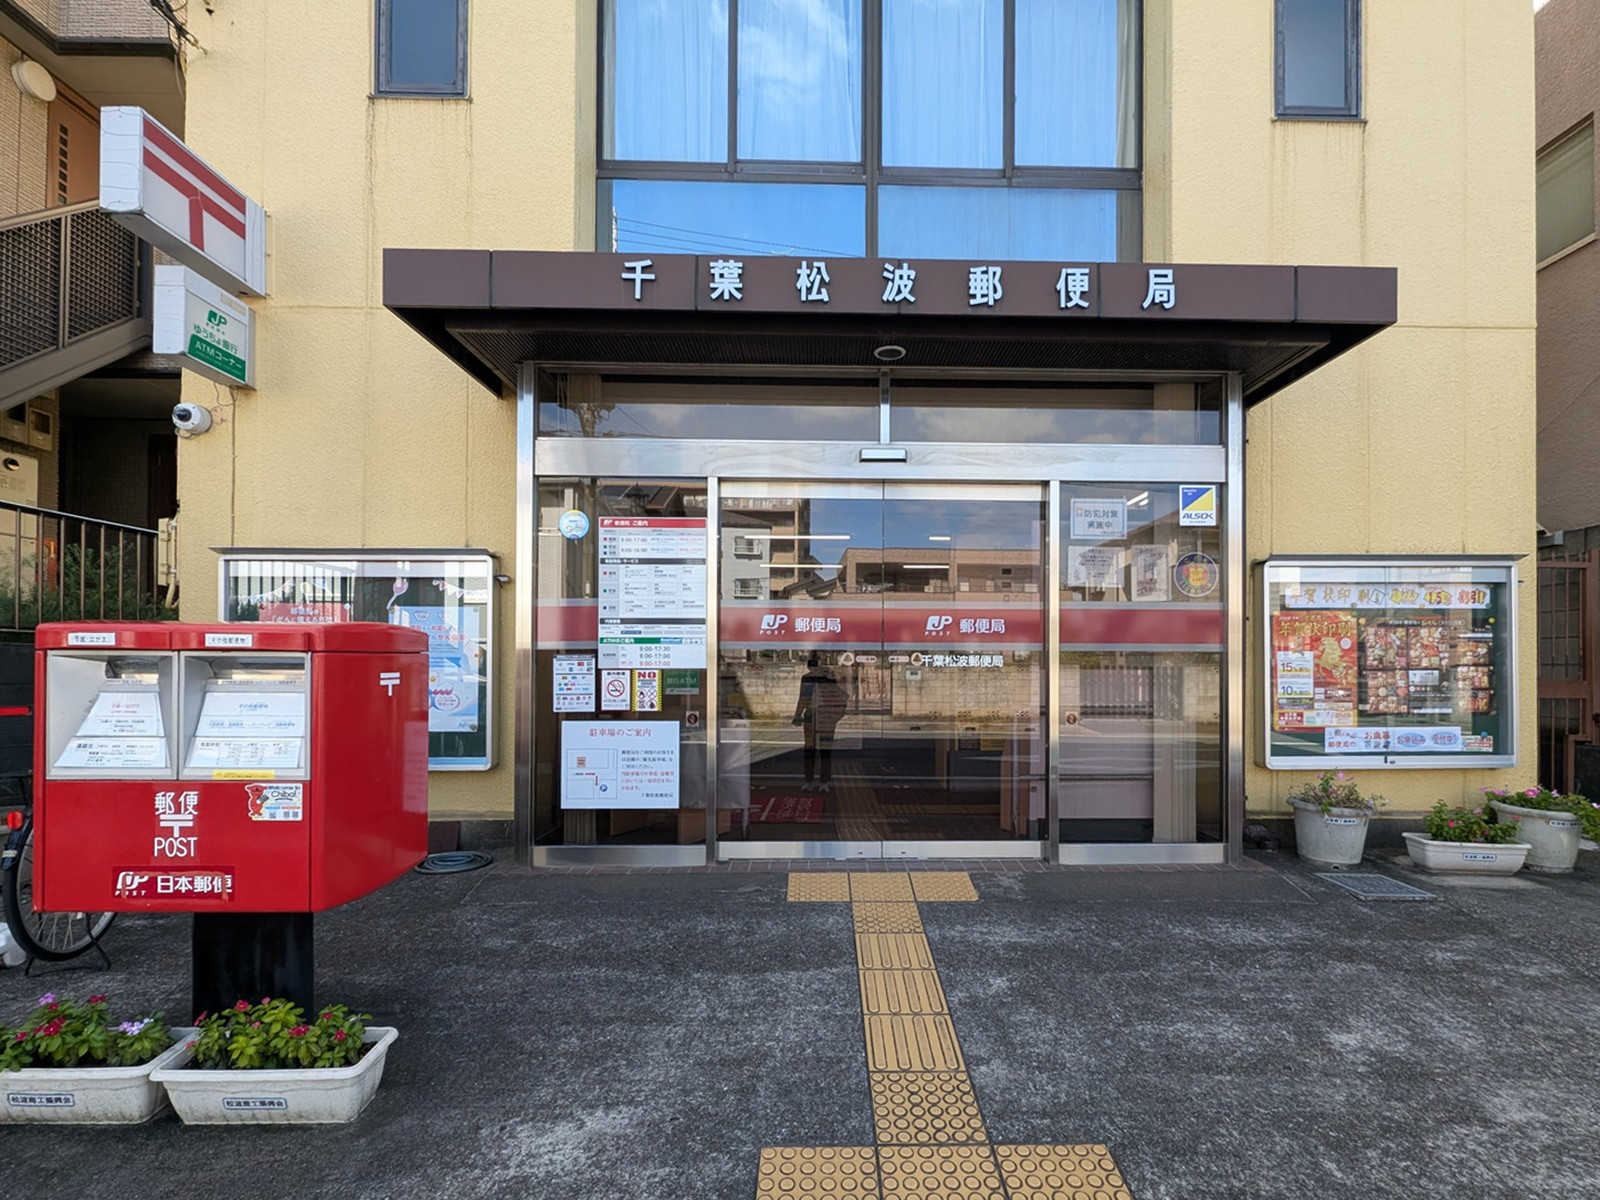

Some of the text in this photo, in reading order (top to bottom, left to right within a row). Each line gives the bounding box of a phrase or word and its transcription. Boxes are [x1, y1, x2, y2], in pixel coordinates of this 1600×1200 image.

[621, 259, 1176, 310] 千葉松波郵便局
[193, 323, 238, 355] ゆうちょ銀行
[195, 341, 242, 369] ATMコーナー
[1084, 509, 1118, 518] 防犯対策
[1182, 512, 1214, 520] ALSOK
[1086, 520, 1113, 529] 実施中
[761, 614, 788, 630] JP
[795, 617, 841, 633] 郵便局
[926, 615, 952, 631] JP
[960, 618, 1006, 634] 郵便局
[1278, 621, 1352, 638] 年賀状印刷
[922, 654, 1004, 668] 千葉松波郵便局
[637, 671, 657, 679] NO
[589, 728, 652, 737] 駐車場のご案内
[154, 791, 199, 815] 郵便
[154, 837, 198, 857] POST
[157, 874, 233, 893] 日本郵便
